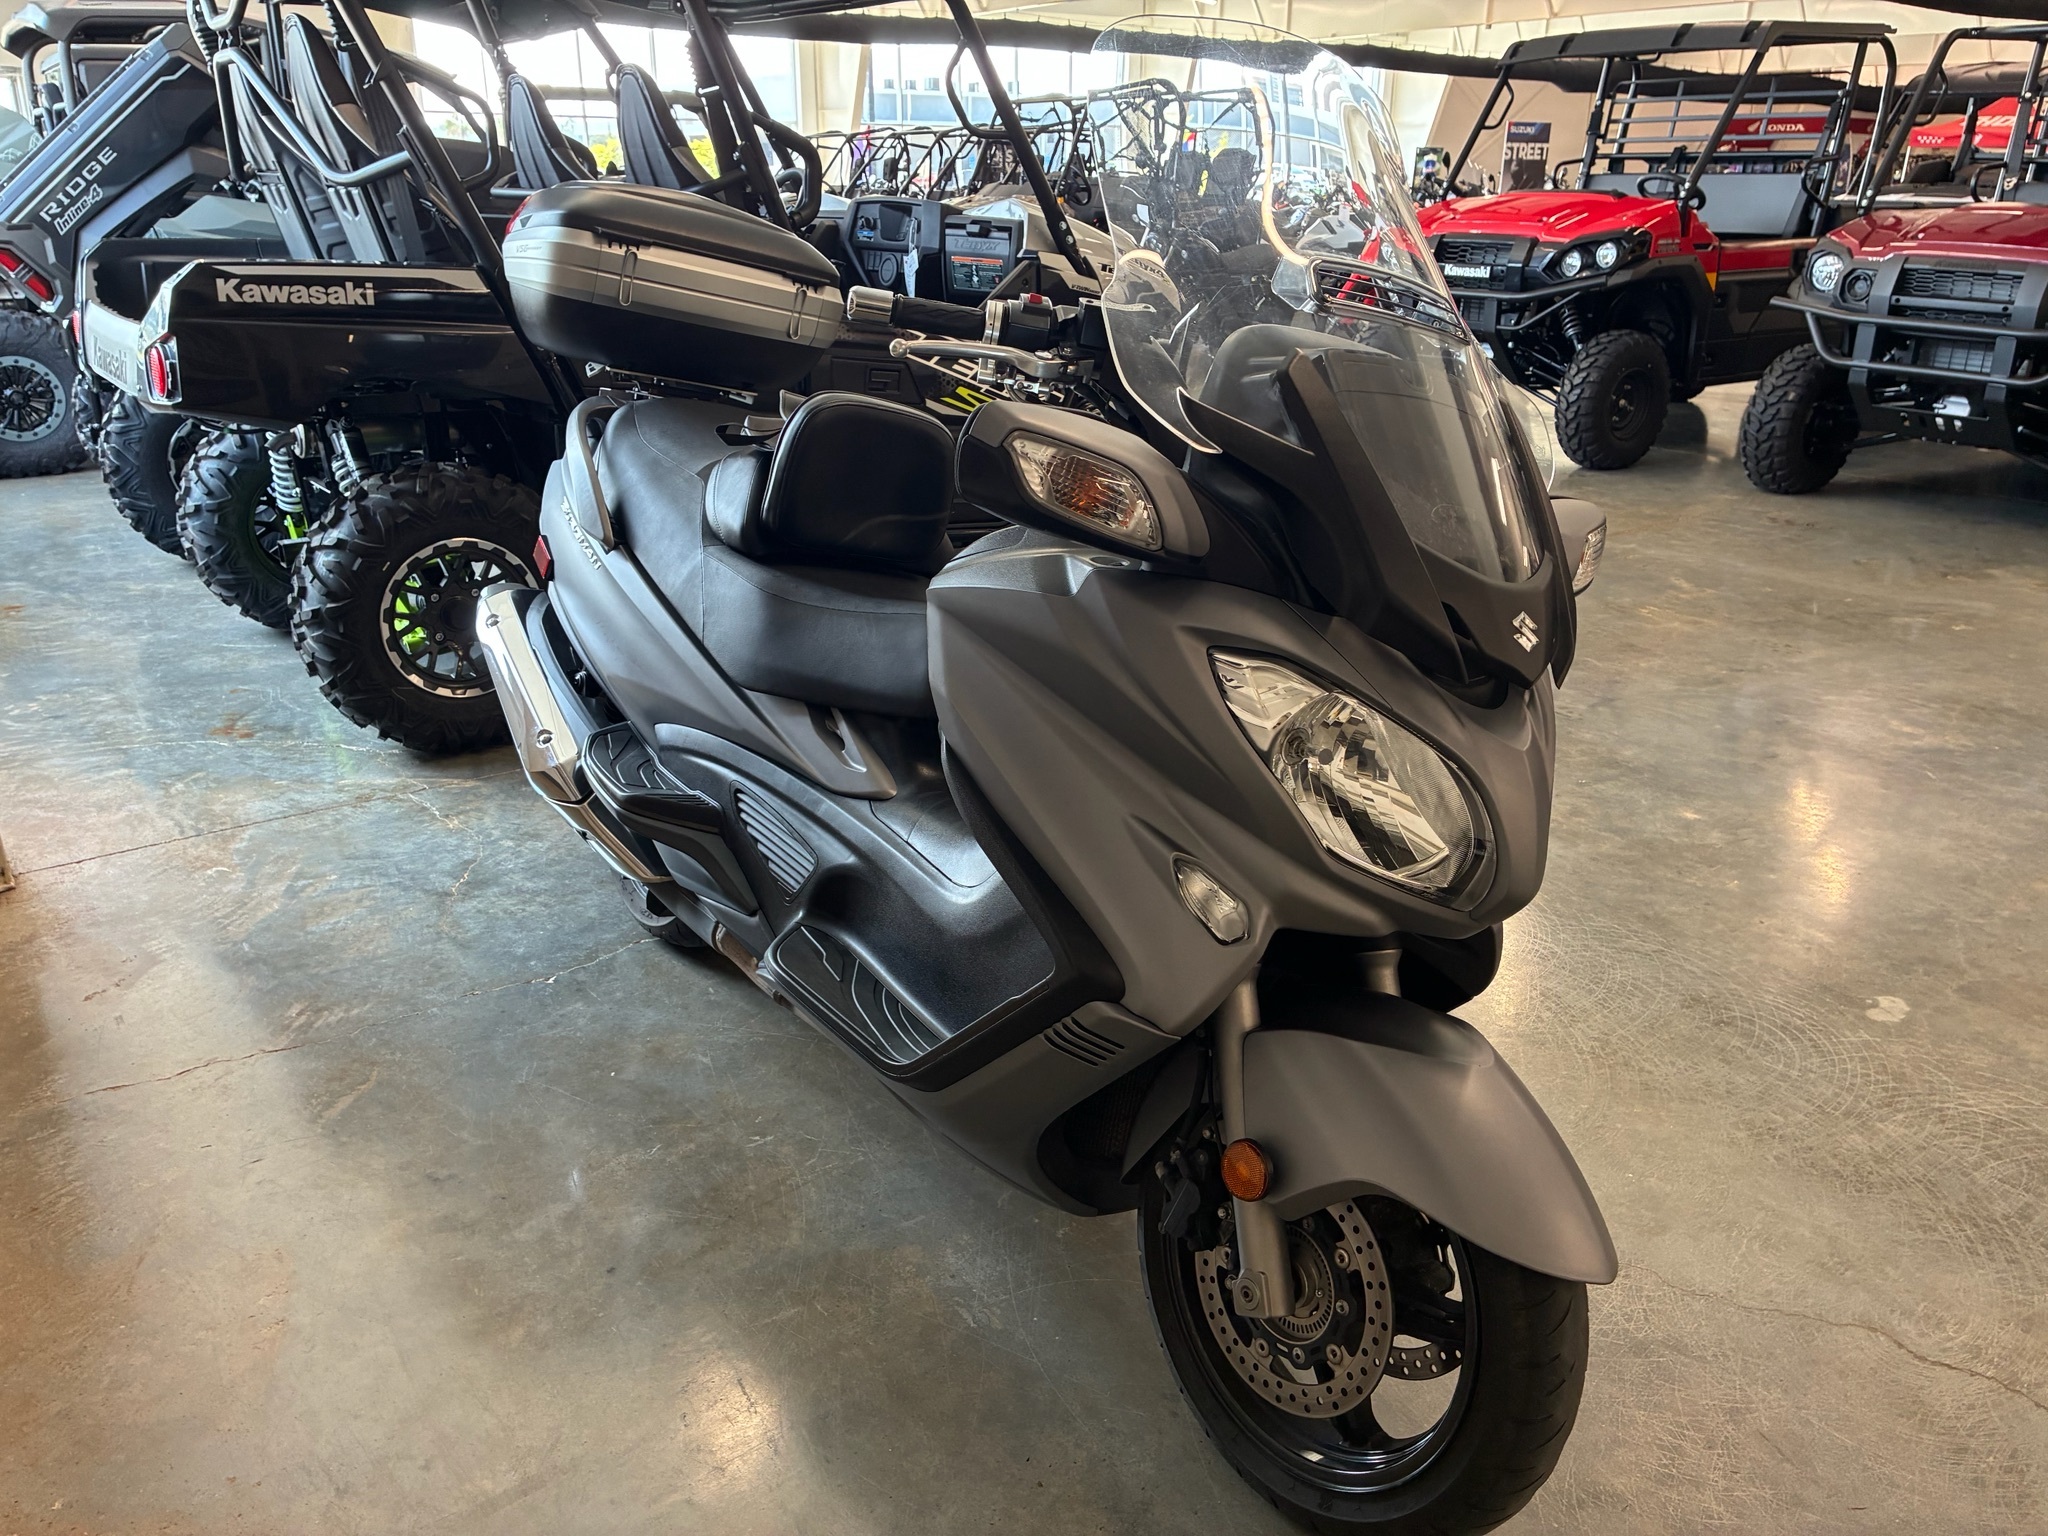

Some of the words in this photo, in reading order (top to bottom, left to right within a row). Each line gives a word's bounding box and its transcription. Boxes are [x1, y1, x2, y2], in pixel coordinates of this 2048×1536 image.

[1510, 125, 1535, 134] SUZUKI
[1766, 123, 1805, 132] ONDA
[1504, 142, 1549, 160] STREET
[39, 146, 118, 222] RIDGE
[1444, 263, 1491, 278] Kawasaki
[215, 278, 375, 306] Kawasaki
[93, 334, 128, 385] Kawasaki
